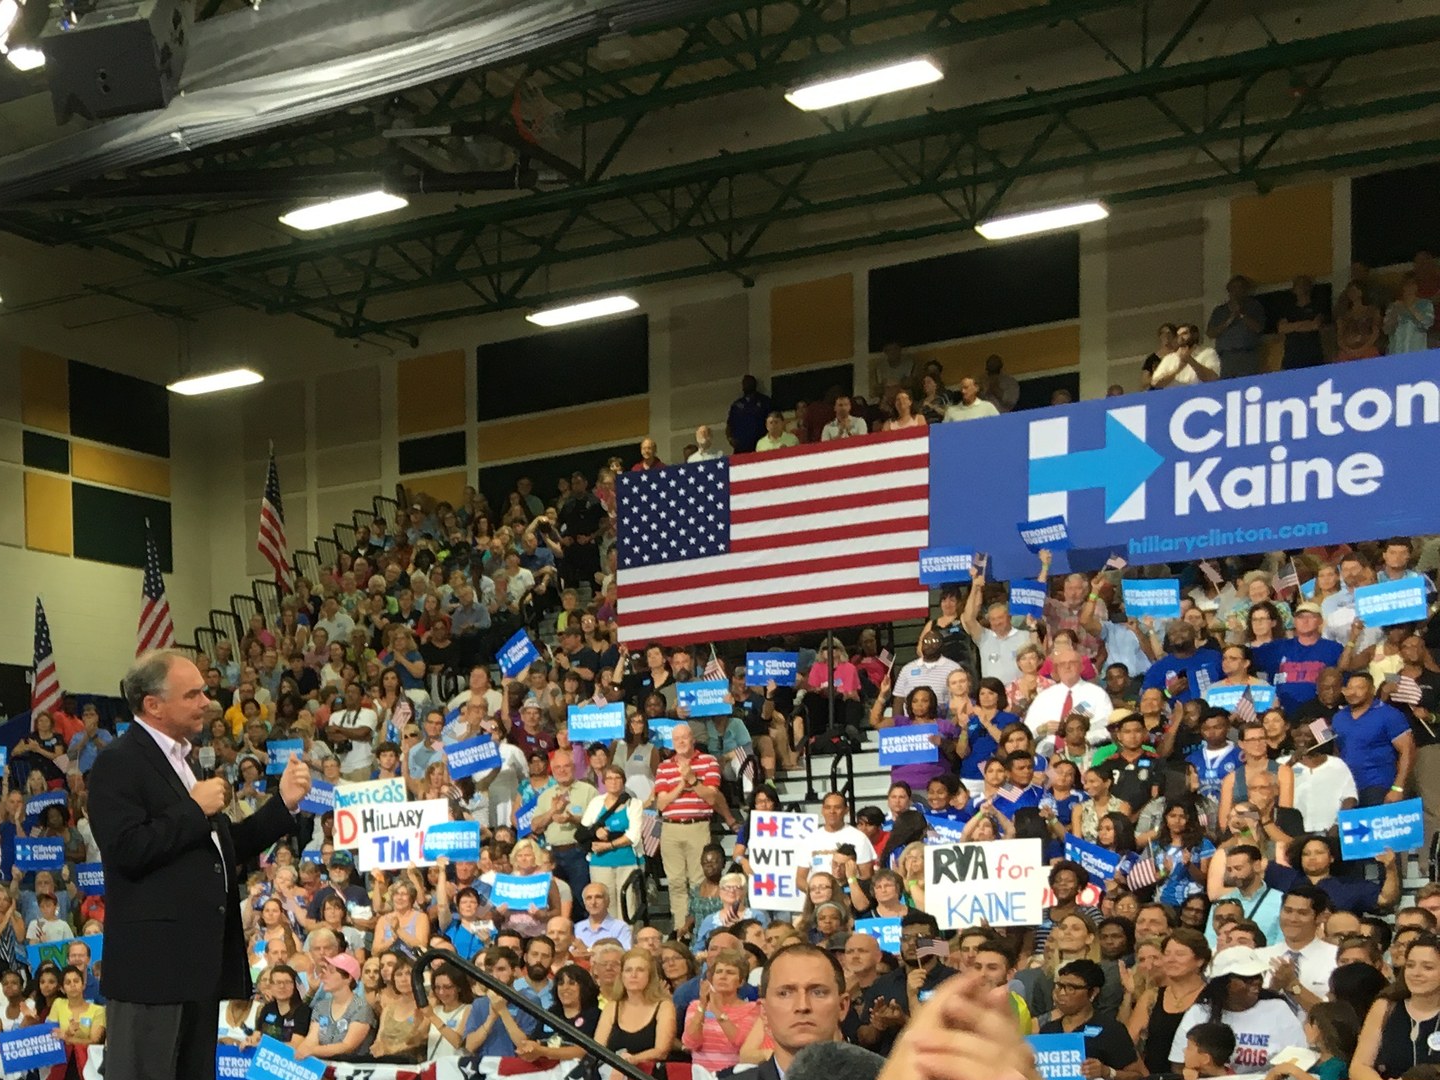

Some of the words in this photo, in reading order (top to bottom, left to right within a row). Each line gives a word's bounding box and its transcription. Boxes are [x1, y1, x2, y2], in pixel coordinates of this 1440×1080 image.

[1169, 378, 1439, 453] Clinton
[1174, 445, 1384, 516] Kaine
[1020, 524, 1065, 541] STRONGER
[1128, 519, 1329, 556] hillaryclinton.com
[921, 554, 972, 565] STRONGER
[921, 562, 972, 573] TOGETHER
[764, 659, 797, 669] Clinton
[764, 668, 790, 676] Kaine
[570, 711, 622, 723] STRONGER
[448, 741, 496, 762] STRONGER
[449, 749, 498, 769] TOGETHER
[334, 780, 404, 810] America's
[1371, 811, 1421, 831] Clinton
[1372, 826, 1412, 842] Kaine
[32, 844, 63, 853] Clinton
[32, 852, 57, 861] Kaine
[752, 848, 794, 867] WIT
[932, 845, 988, 885] RVA
[995, 854, 1035, 880] for
[1081, 852, 1115, 873] Clinton
[78, 870, 104, 880] STRON
[1081, 862, 1105, 879] Kaine
[78, 879, 104, 887] TOGET
[947, 892, 1027, 927] KAINE
[3, 1041, 62, 1062] TOGETHER
[1234, 1046, 1268, 1067] 2016
[218, 1056, 252, 1068] STRON
[258, 1047, 318, 1080] STRONGER
[218, 1067, 248, 1079] TOGE
[1037, 1064, 1082, 1078] THER
